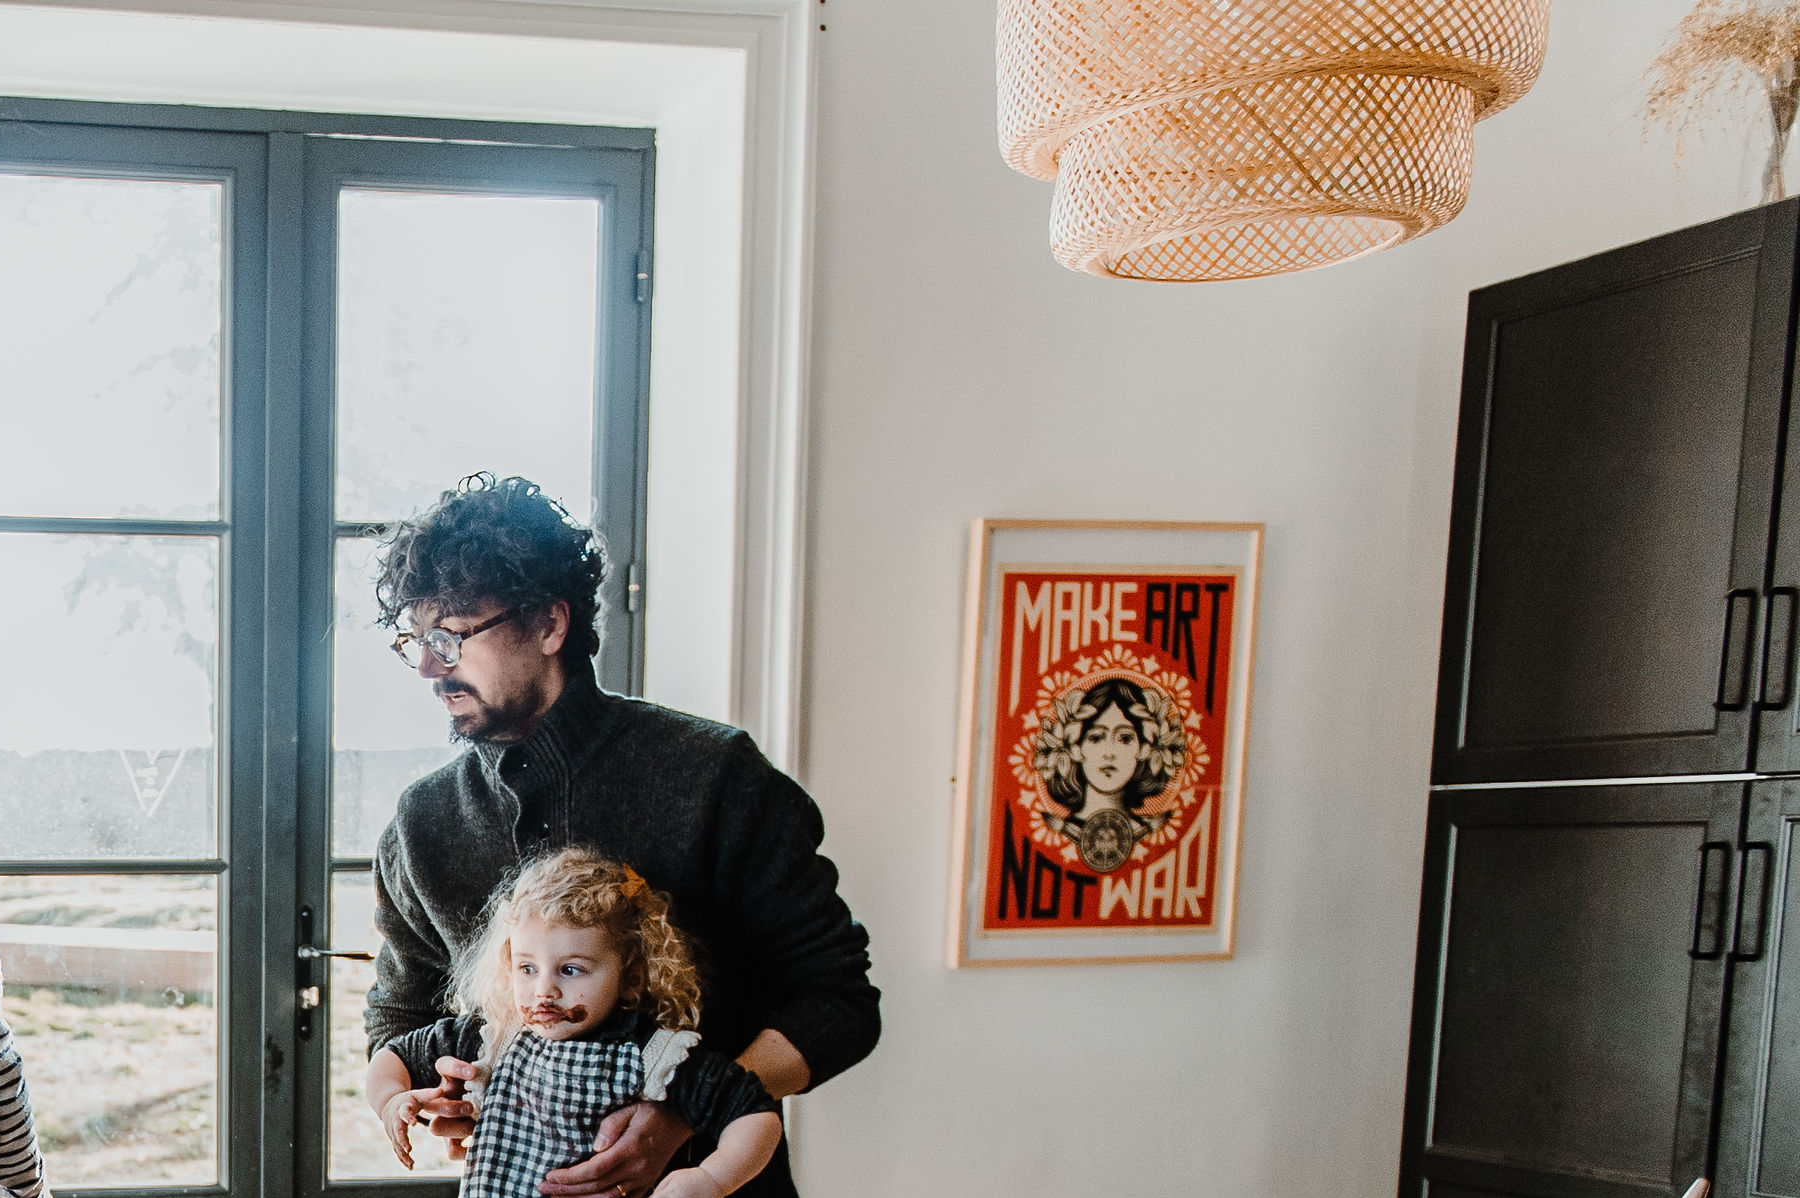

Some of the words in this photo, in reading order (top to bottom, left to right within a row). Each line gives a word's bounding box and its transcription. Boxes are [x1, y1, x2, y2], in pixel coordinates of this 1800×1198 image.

[1009, 581, 1138, 717] MAKE
[1144, 582, 1229, 717] ART
[998, 799, 1098, 920] NOT
[1100, 788, 1214, 919] WAR
